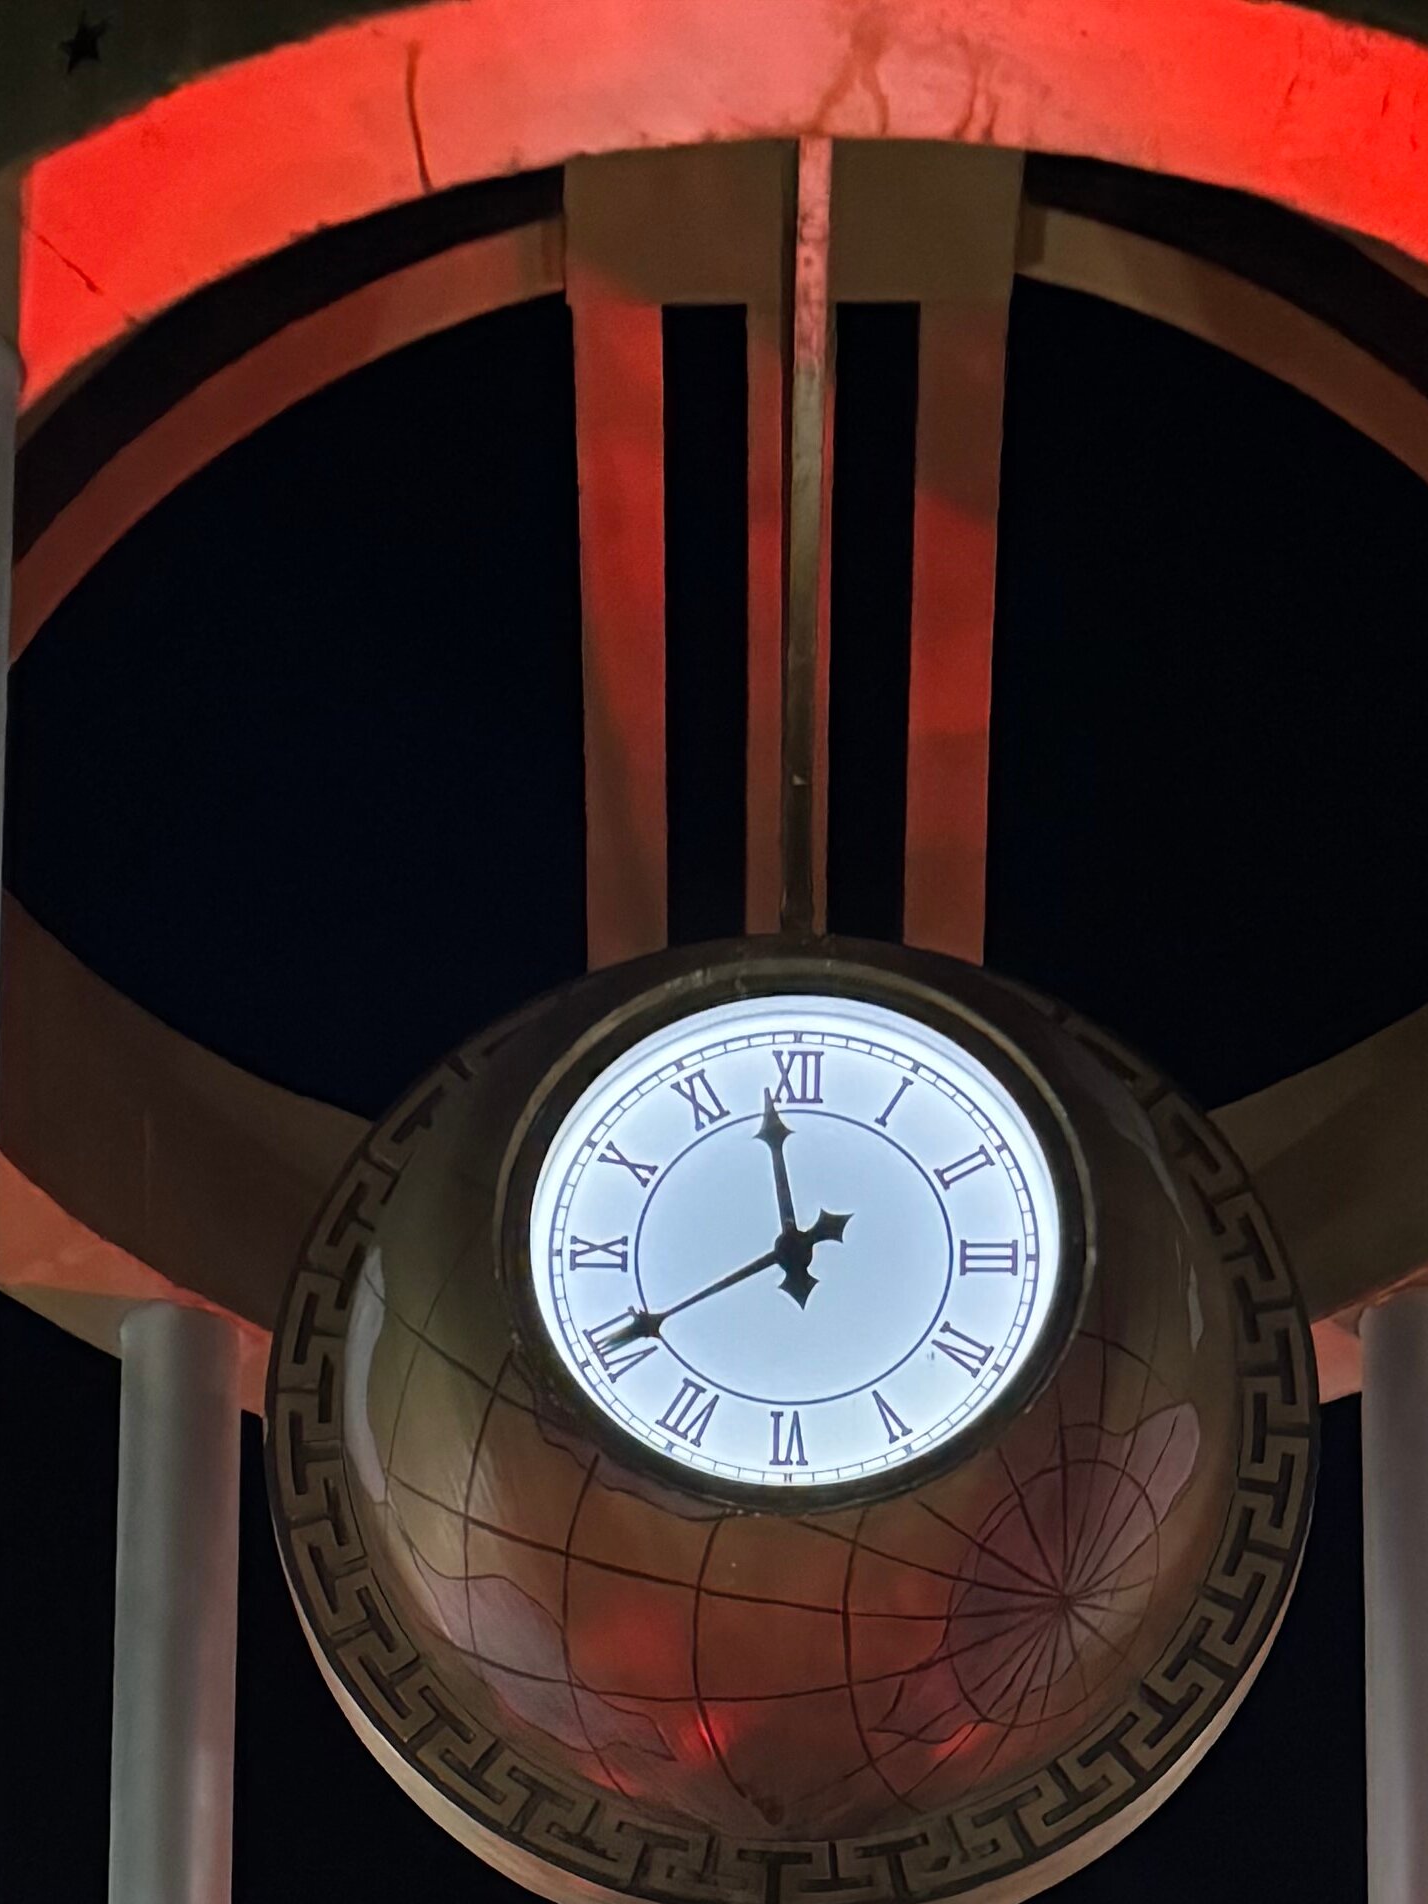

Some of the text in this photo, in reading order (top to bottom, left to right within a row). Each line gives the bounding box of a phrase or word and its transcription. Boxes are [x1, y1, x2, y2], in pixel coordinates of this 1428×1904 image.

[670, 1069, 731, 1132] XI
[772, 1050, 824, 1104] XII
[874, 1077, 914, 1128] I
[597, 1141, 659, 1188] X
[933, 1144, 995, 1191] II
[570, 1236, 628, 1273] IX
[960, 1240, 1018, 1276] III
[931, 1321, 994, 1378] IV
[655, 1377, 720, 1448] VII
[769, 1410, 808, 1466] VI
[872, 1390, 913, 1444] V
